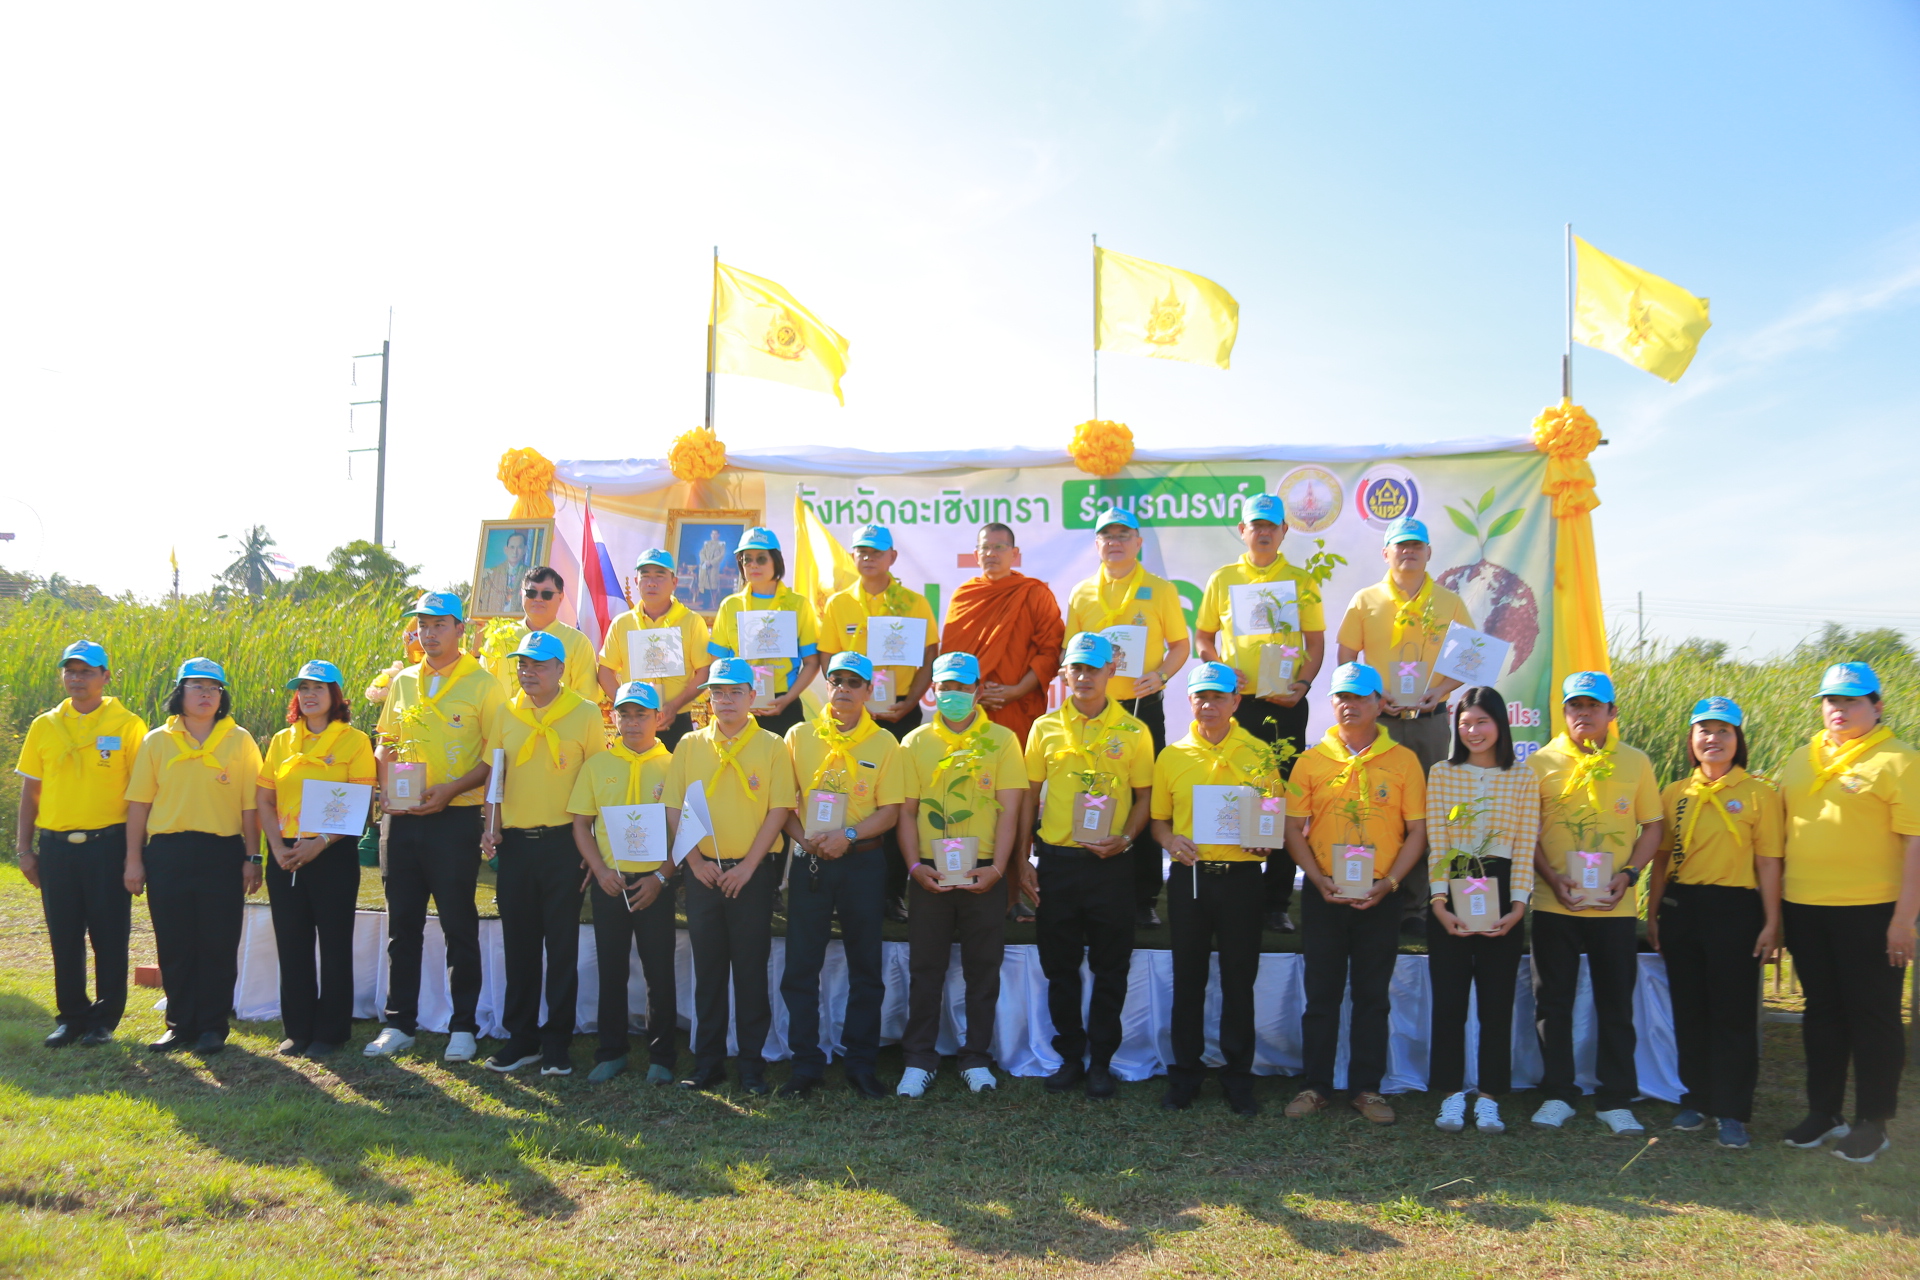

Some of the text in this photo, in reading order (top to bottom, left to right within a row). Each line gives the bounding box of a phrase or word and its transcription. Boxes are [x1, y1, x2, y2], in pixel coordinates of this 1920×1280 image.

[803, 487, 1049, 525] ังหวัดฉะเชิงเทรา
[1508, 703, 1540, 725] ils:
